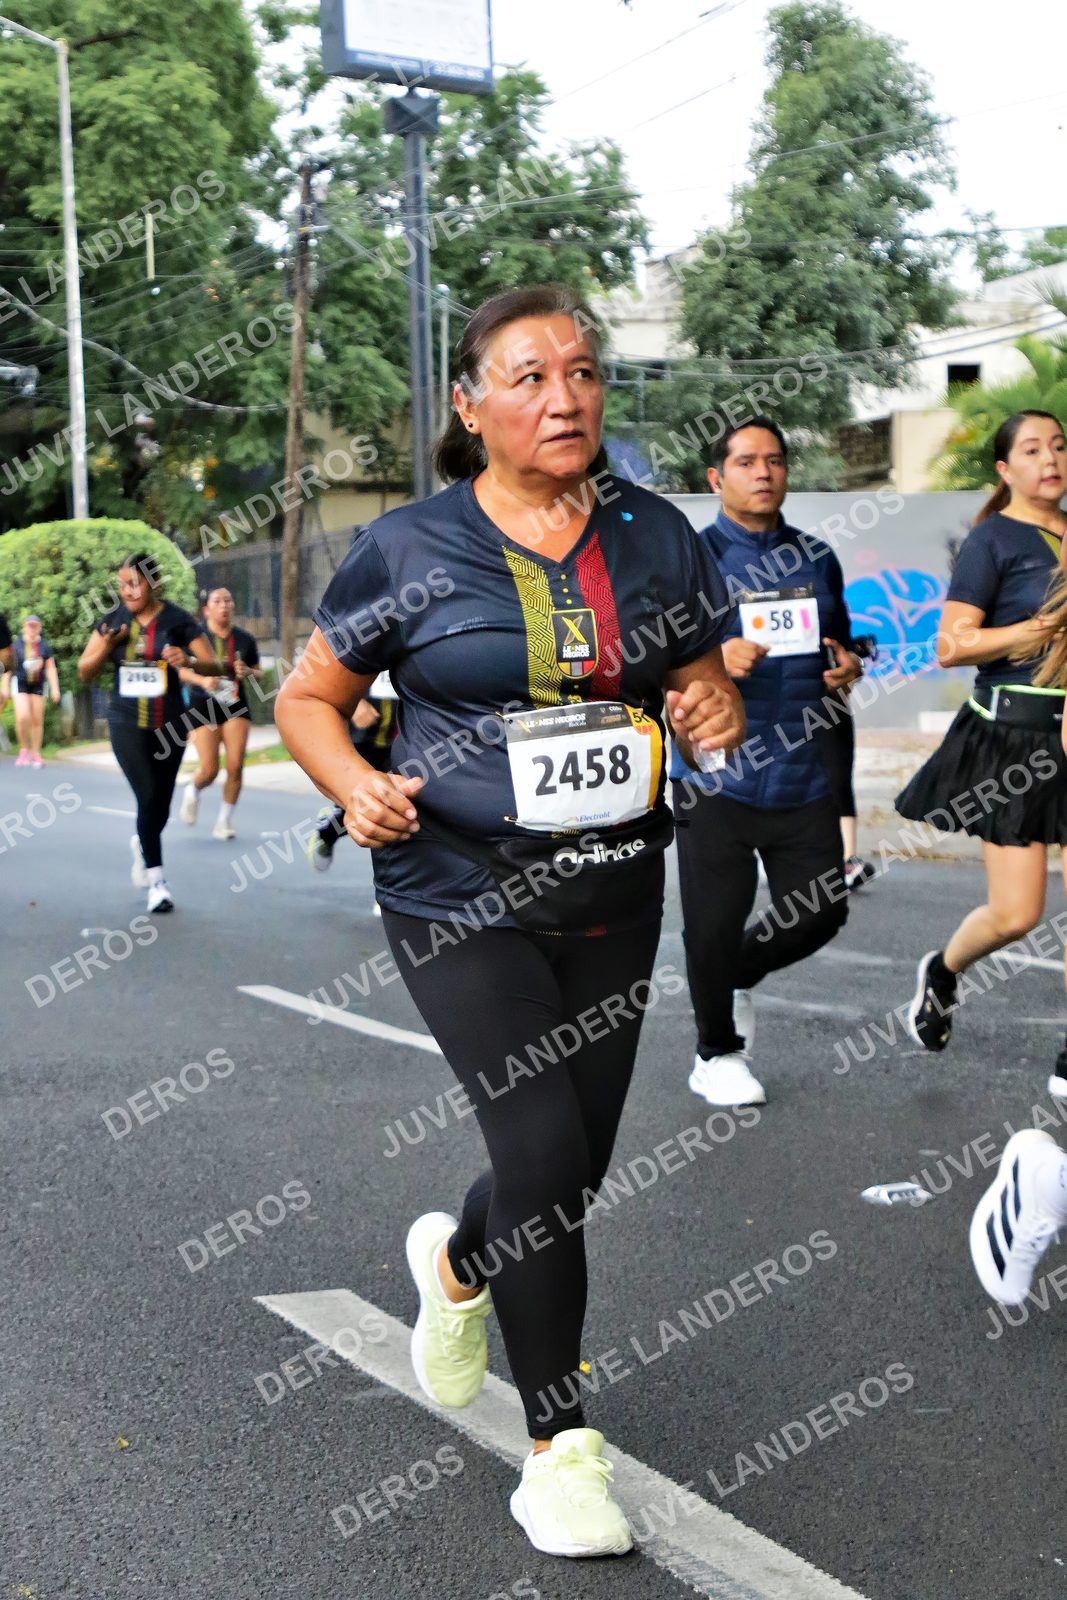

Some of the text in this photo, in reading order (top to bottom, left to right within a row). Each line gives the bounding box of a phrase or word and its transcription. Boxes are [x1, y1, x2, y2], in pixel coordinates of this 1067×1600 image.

[770, 609, 793, 631] 58
[563, 644, 590, 652] LENES
[526, 713, 586, 728] LENES NEGROS
[531, 744, 631, 796] 2458
[579, 811, 611, 823] Electrolit
